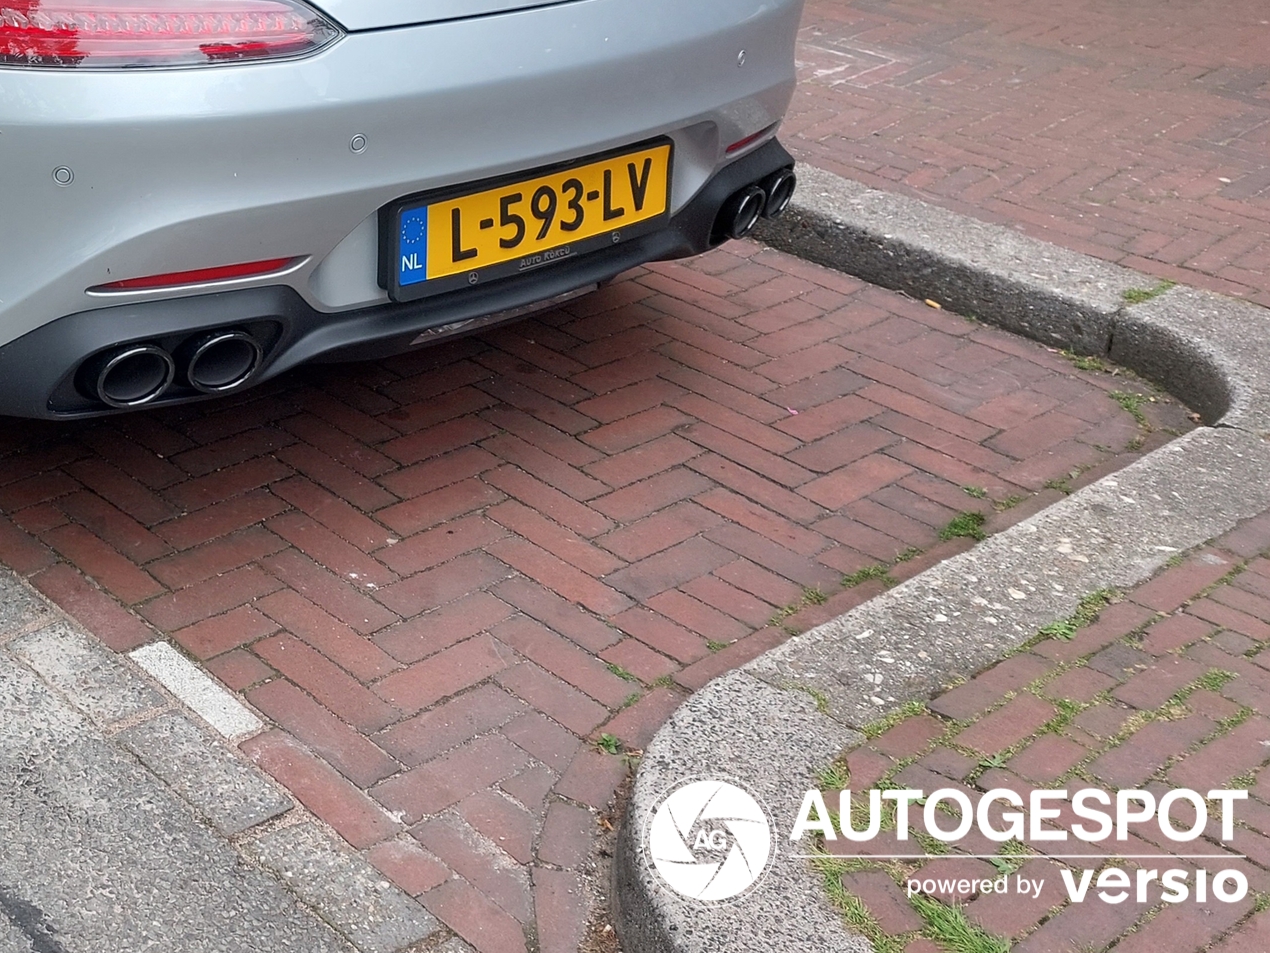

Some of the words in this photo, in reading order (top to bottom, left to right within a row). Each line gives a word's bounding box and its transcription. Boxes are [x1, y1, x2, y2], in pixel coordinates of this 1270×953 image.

[451, 158, 652, 263] L-593-LV
[401, 253, 423, 272] NL
[519, 255, 542, 268] AUTO
